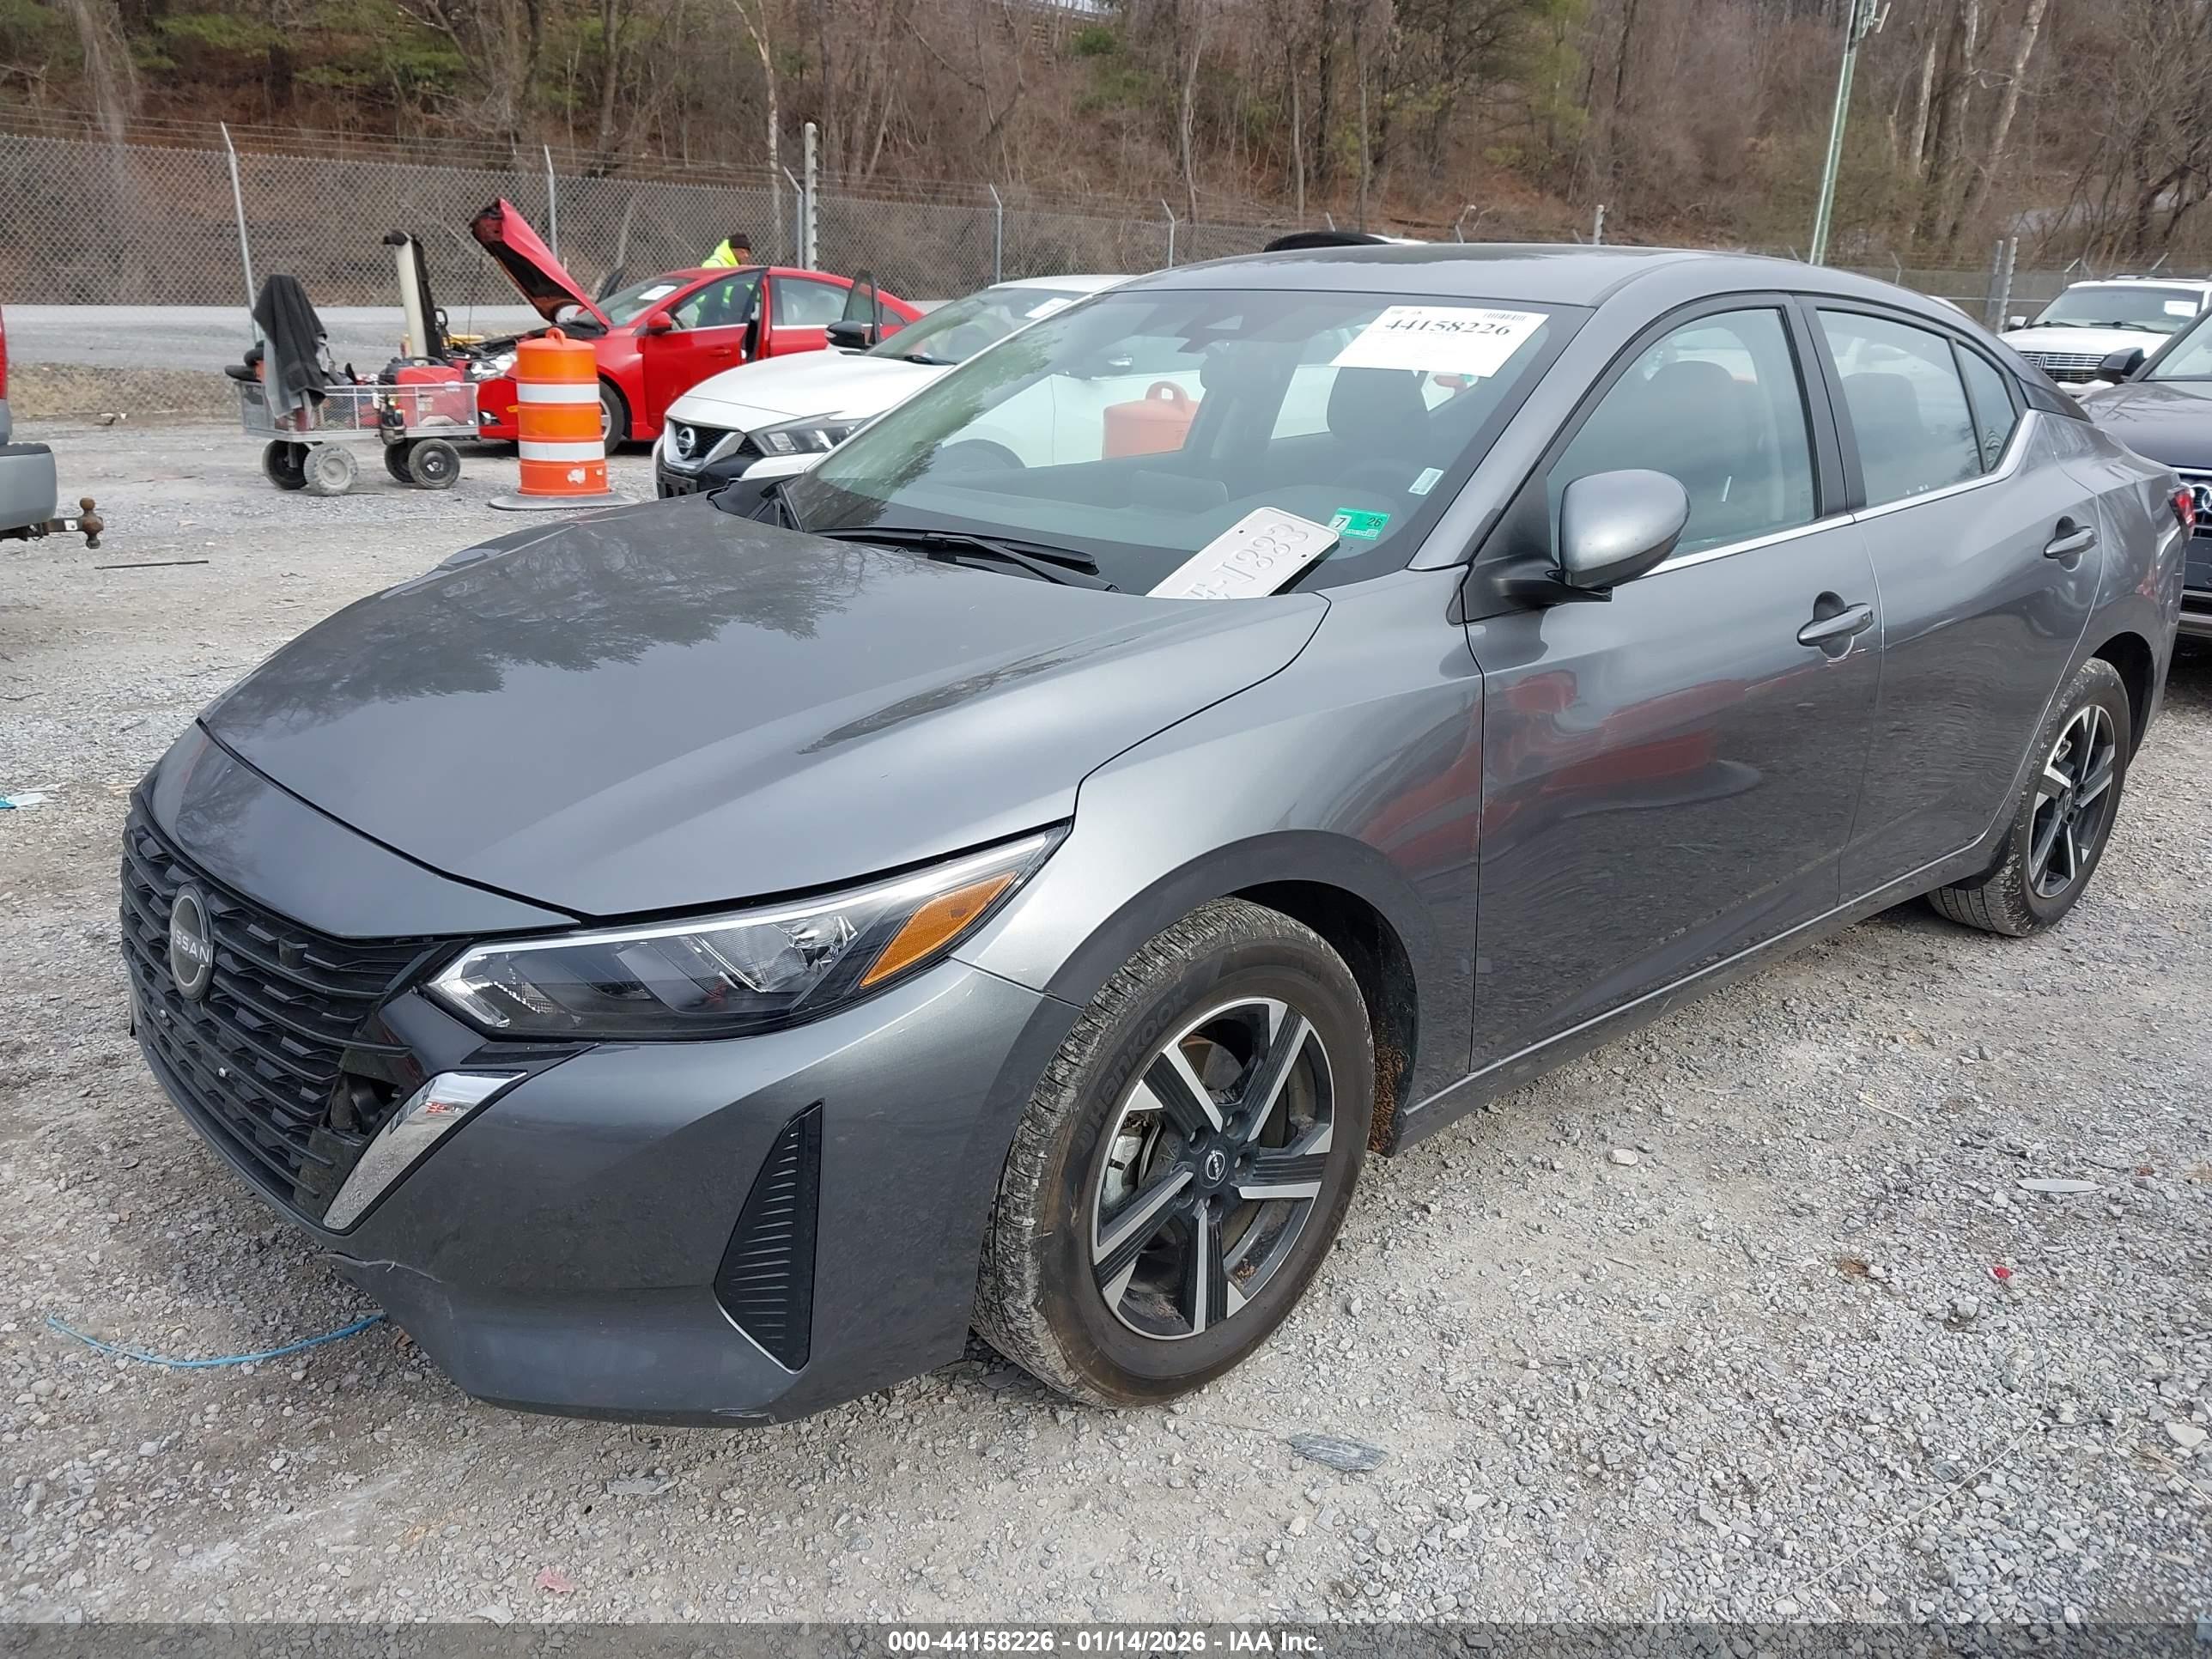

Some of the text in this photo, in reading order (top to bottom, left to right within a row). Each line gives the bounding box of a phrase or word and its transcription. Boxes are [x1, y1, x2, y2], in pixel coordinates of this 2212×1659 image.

[1384, 319, 1511, 336] 44158226
[1334, 517, 1383, 528] 7 26
[171, 927, 210, 963] ISSAN
